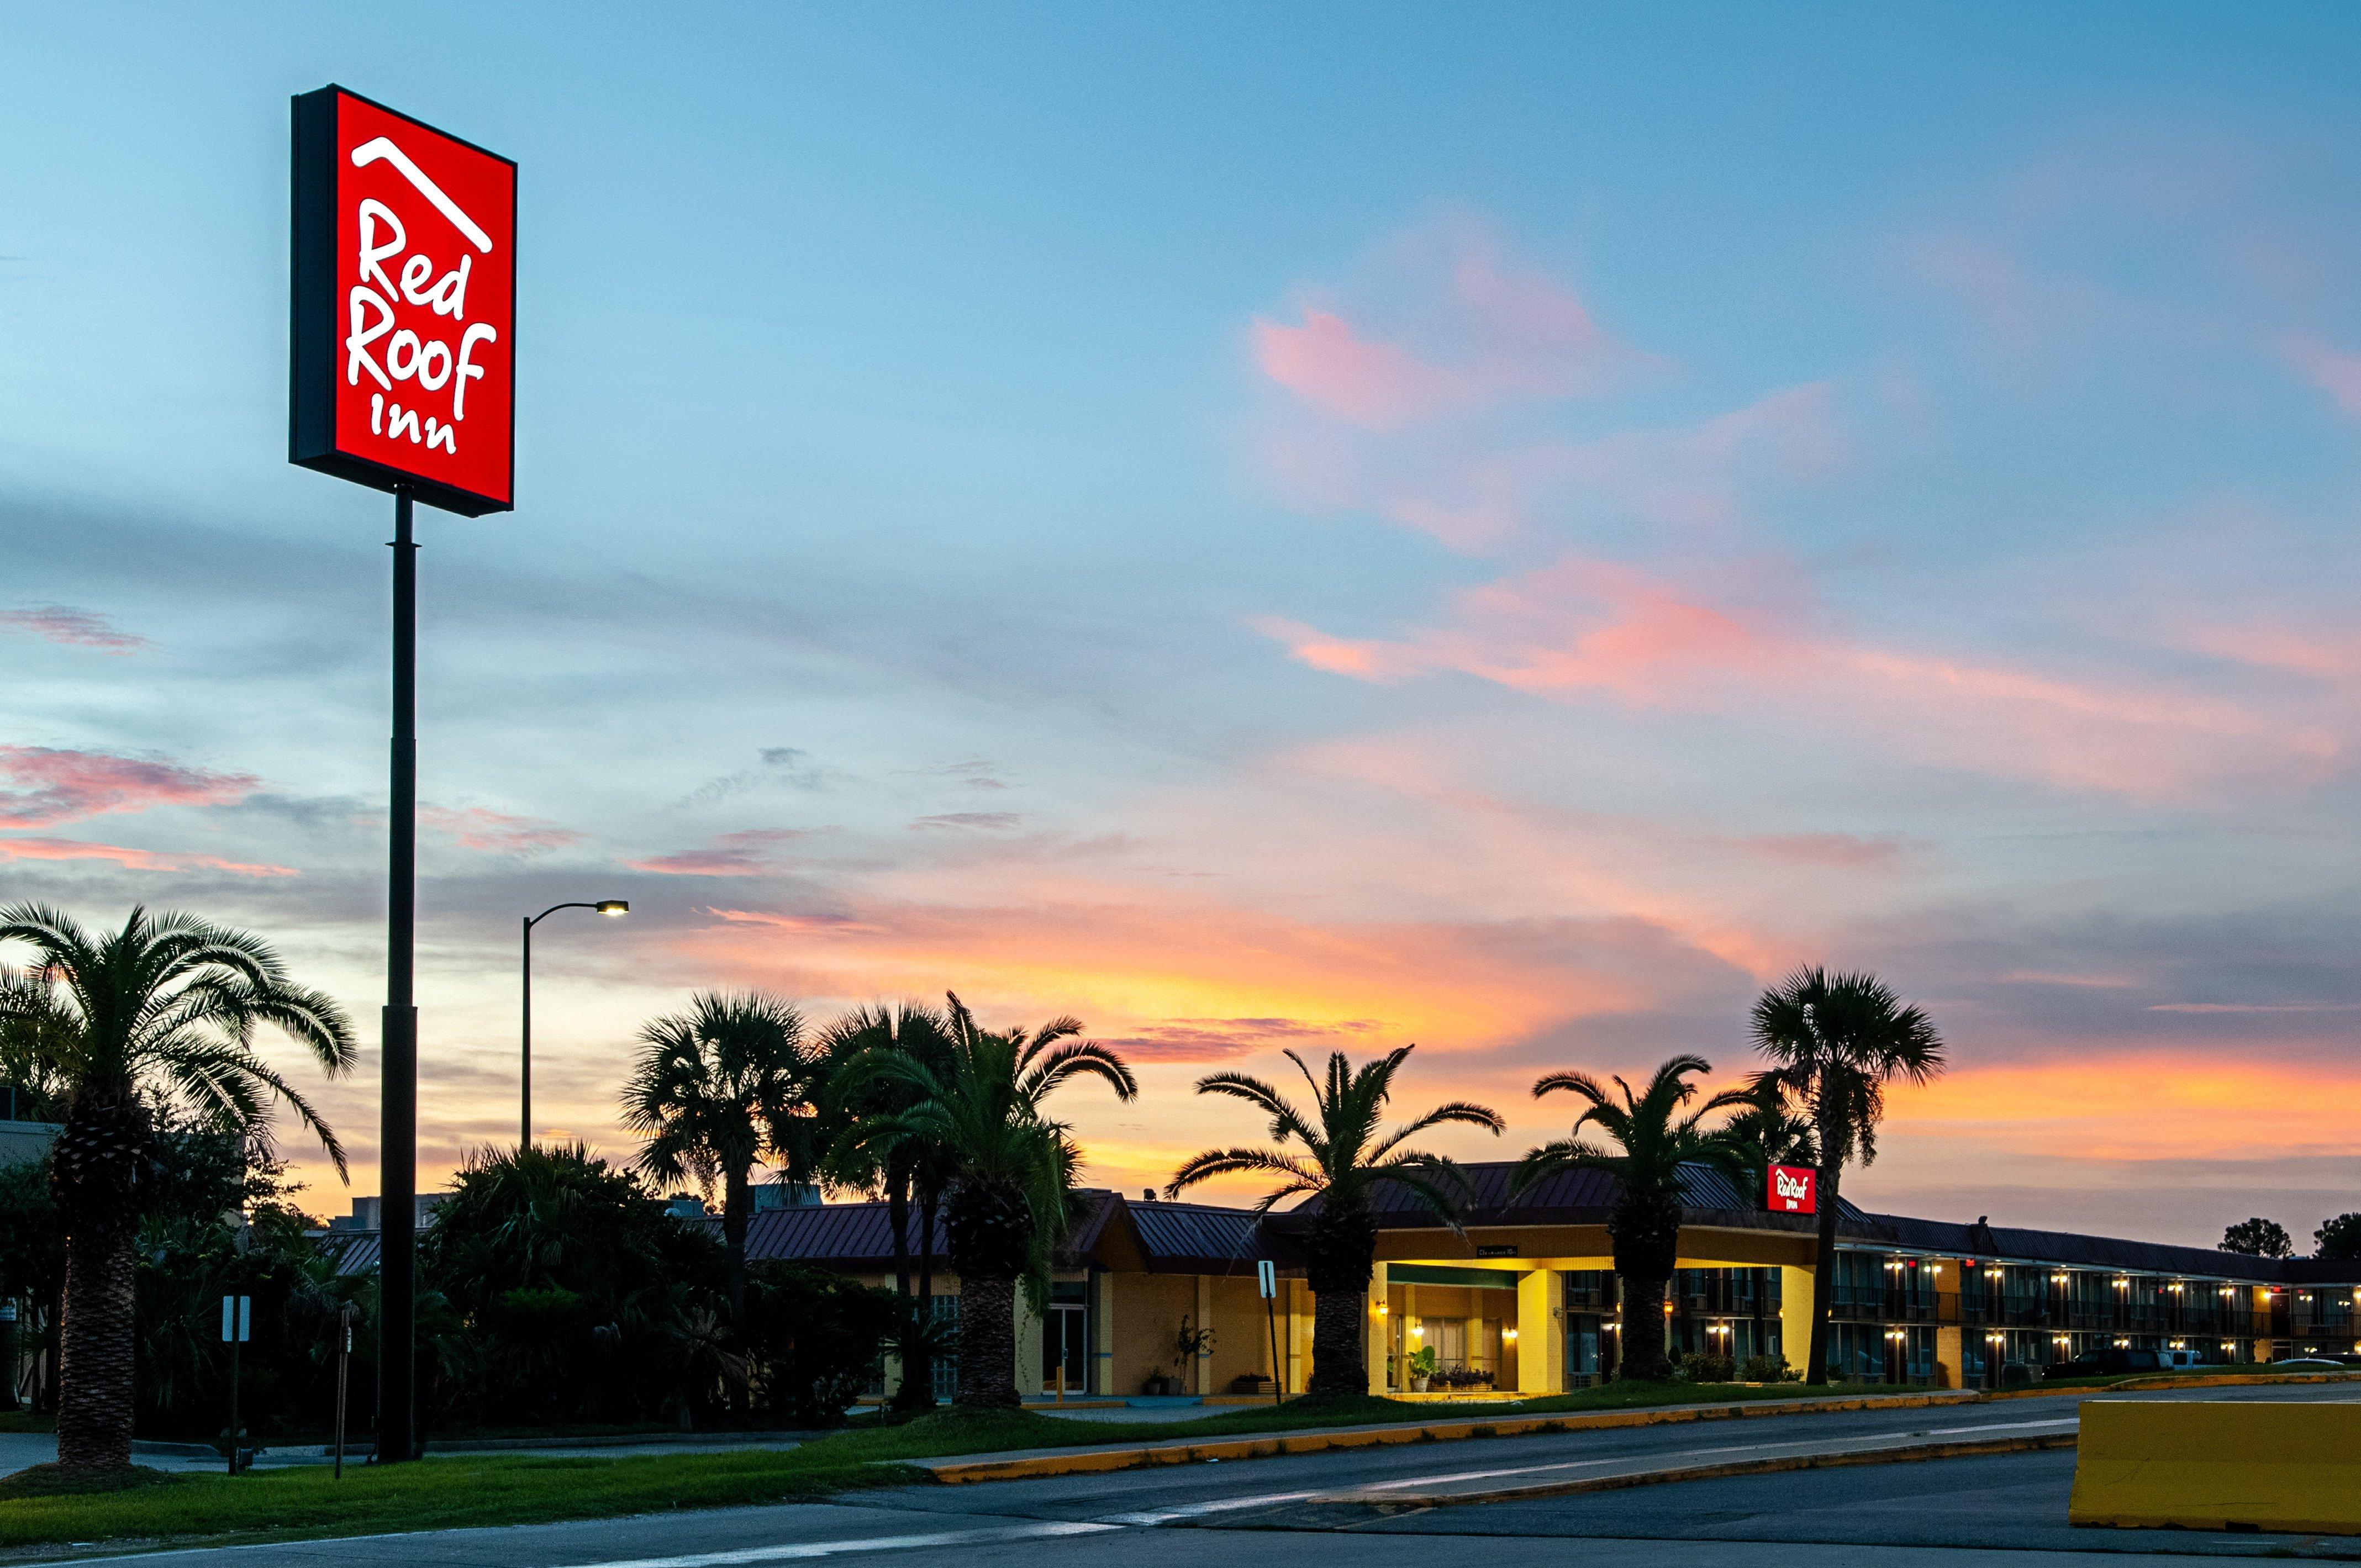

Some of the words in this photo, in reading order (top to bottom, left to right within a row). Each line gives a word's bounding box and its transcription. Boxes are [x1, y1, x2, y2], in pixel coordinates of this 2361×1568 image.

[359, 198, 472, 321] Red
[345, 285, 497, 421] Roof
[1777, 1175, 1790, 1197] Red
[1790, 1176, 1808, 1200] Roof
